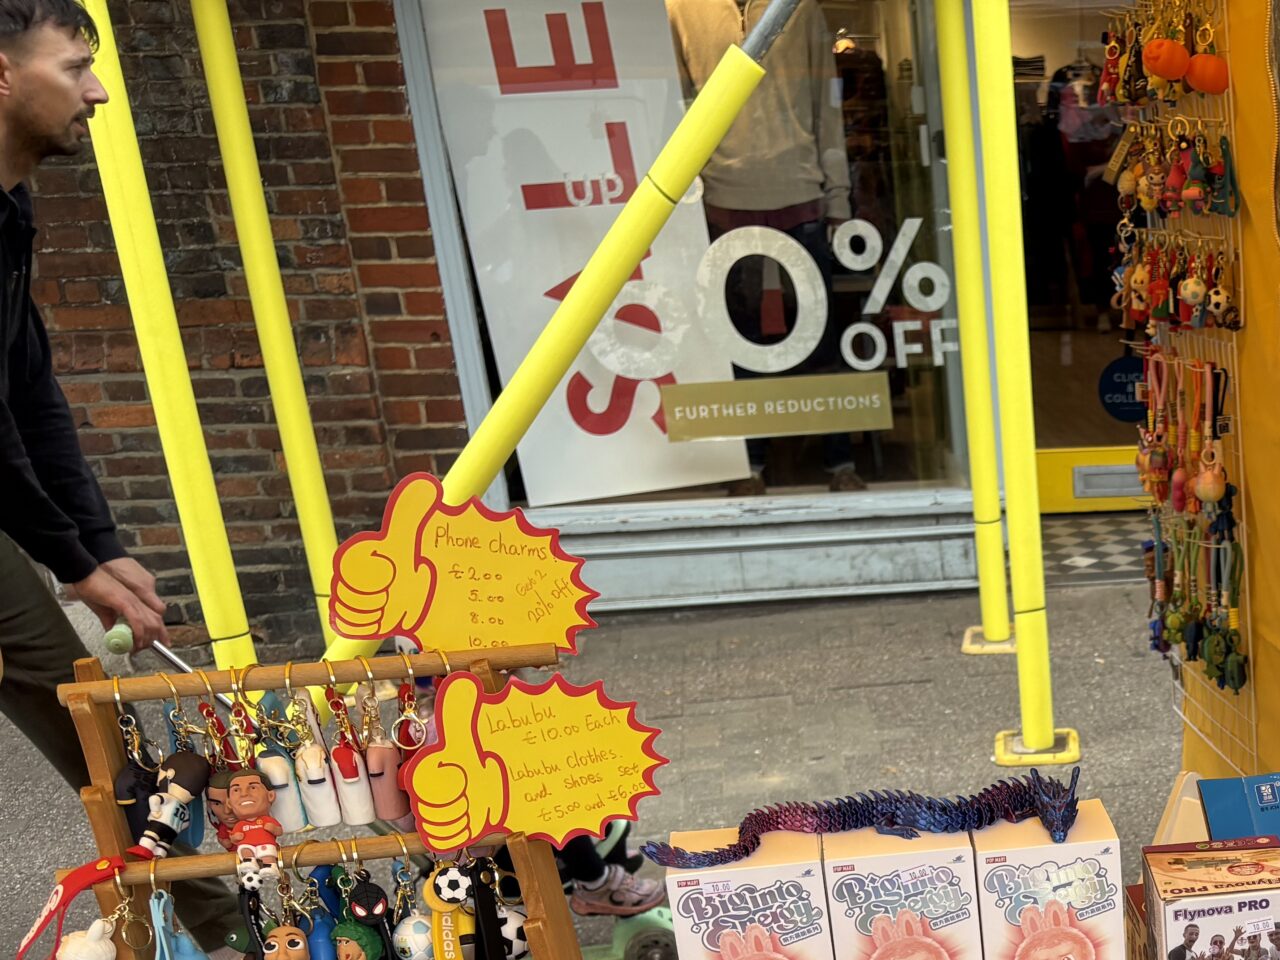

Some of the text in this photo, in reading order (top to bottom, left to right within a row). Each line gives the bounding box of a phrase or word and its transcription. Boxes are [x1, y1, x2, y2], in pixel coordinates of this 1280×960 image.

[564, 173, 624, 207] UP
[839, 320, 960, 371] OFF
[675, 394, 882, 420] FURTHER REDUCTIONS
[434, 522, 481, 549] Phone
[448, 563, 503, 581] £2.00
[468, 589, 505, 603] 5.00
[527, 590, 554, 624] 20%
[469, 611, 505, 625] 8.00
[468, 635, 509, 648] 10.00
[486, 701, 556, 735] Labubu
[522, 710, 621, 745] £10.00 Each
[524, 783, 552, 803] and
[537, 782, 646, 822] £5.00 and £6.00
[173, 807, 186, 821] 10
[711, 882, 731, 893] 10.00
[1173, 899, 1270, 921] Flynova PRO
[442, 912, 456, 960] didas
